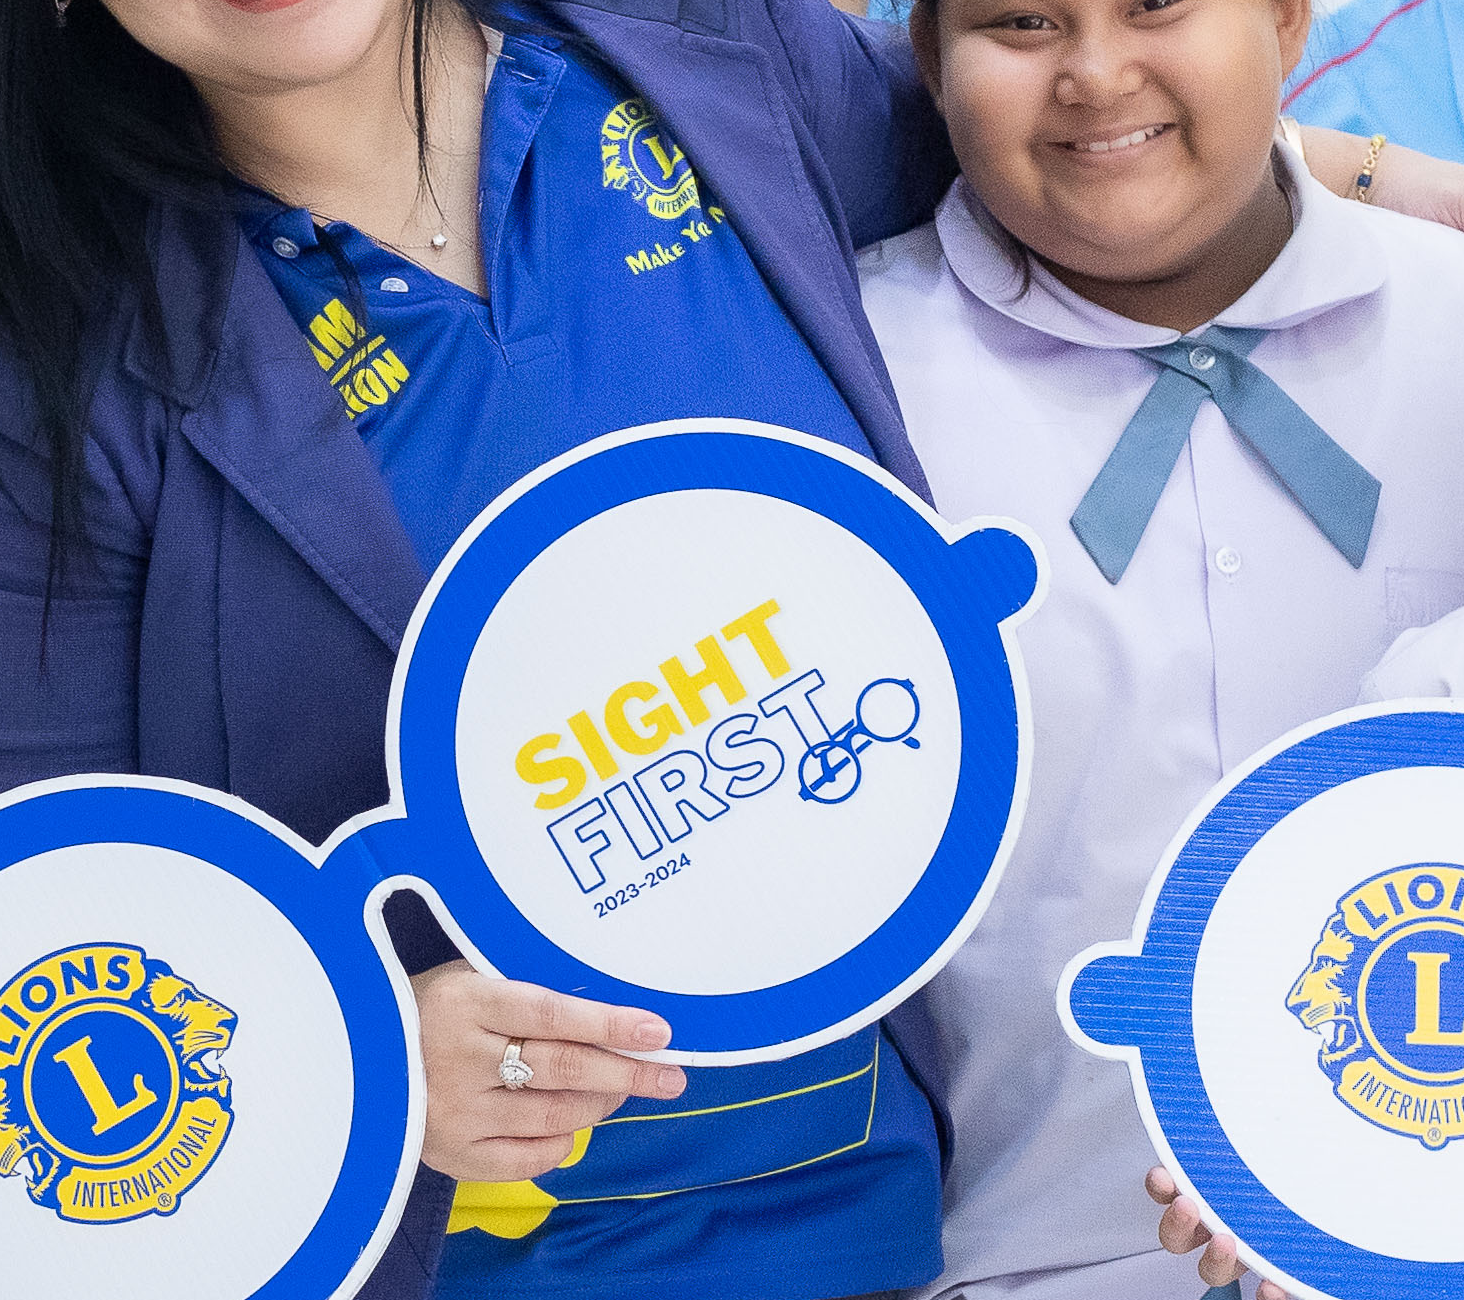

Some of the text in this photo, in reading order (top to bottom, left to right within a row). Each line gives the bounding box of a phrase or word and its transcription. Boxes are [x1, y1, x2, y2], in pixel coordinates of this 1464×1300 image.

[607, 101, 644, 133] LIO
[342, 348, 410, 420] ION
[515, 598, 792, 810] SIGHT
[546, 668, 825, 894] FIRST
[593, 852, 692, 918] 2023-2024
[52, 1035, 158, 1137] L
[72, 1115, 217, 1208] INTERNATIONAL
